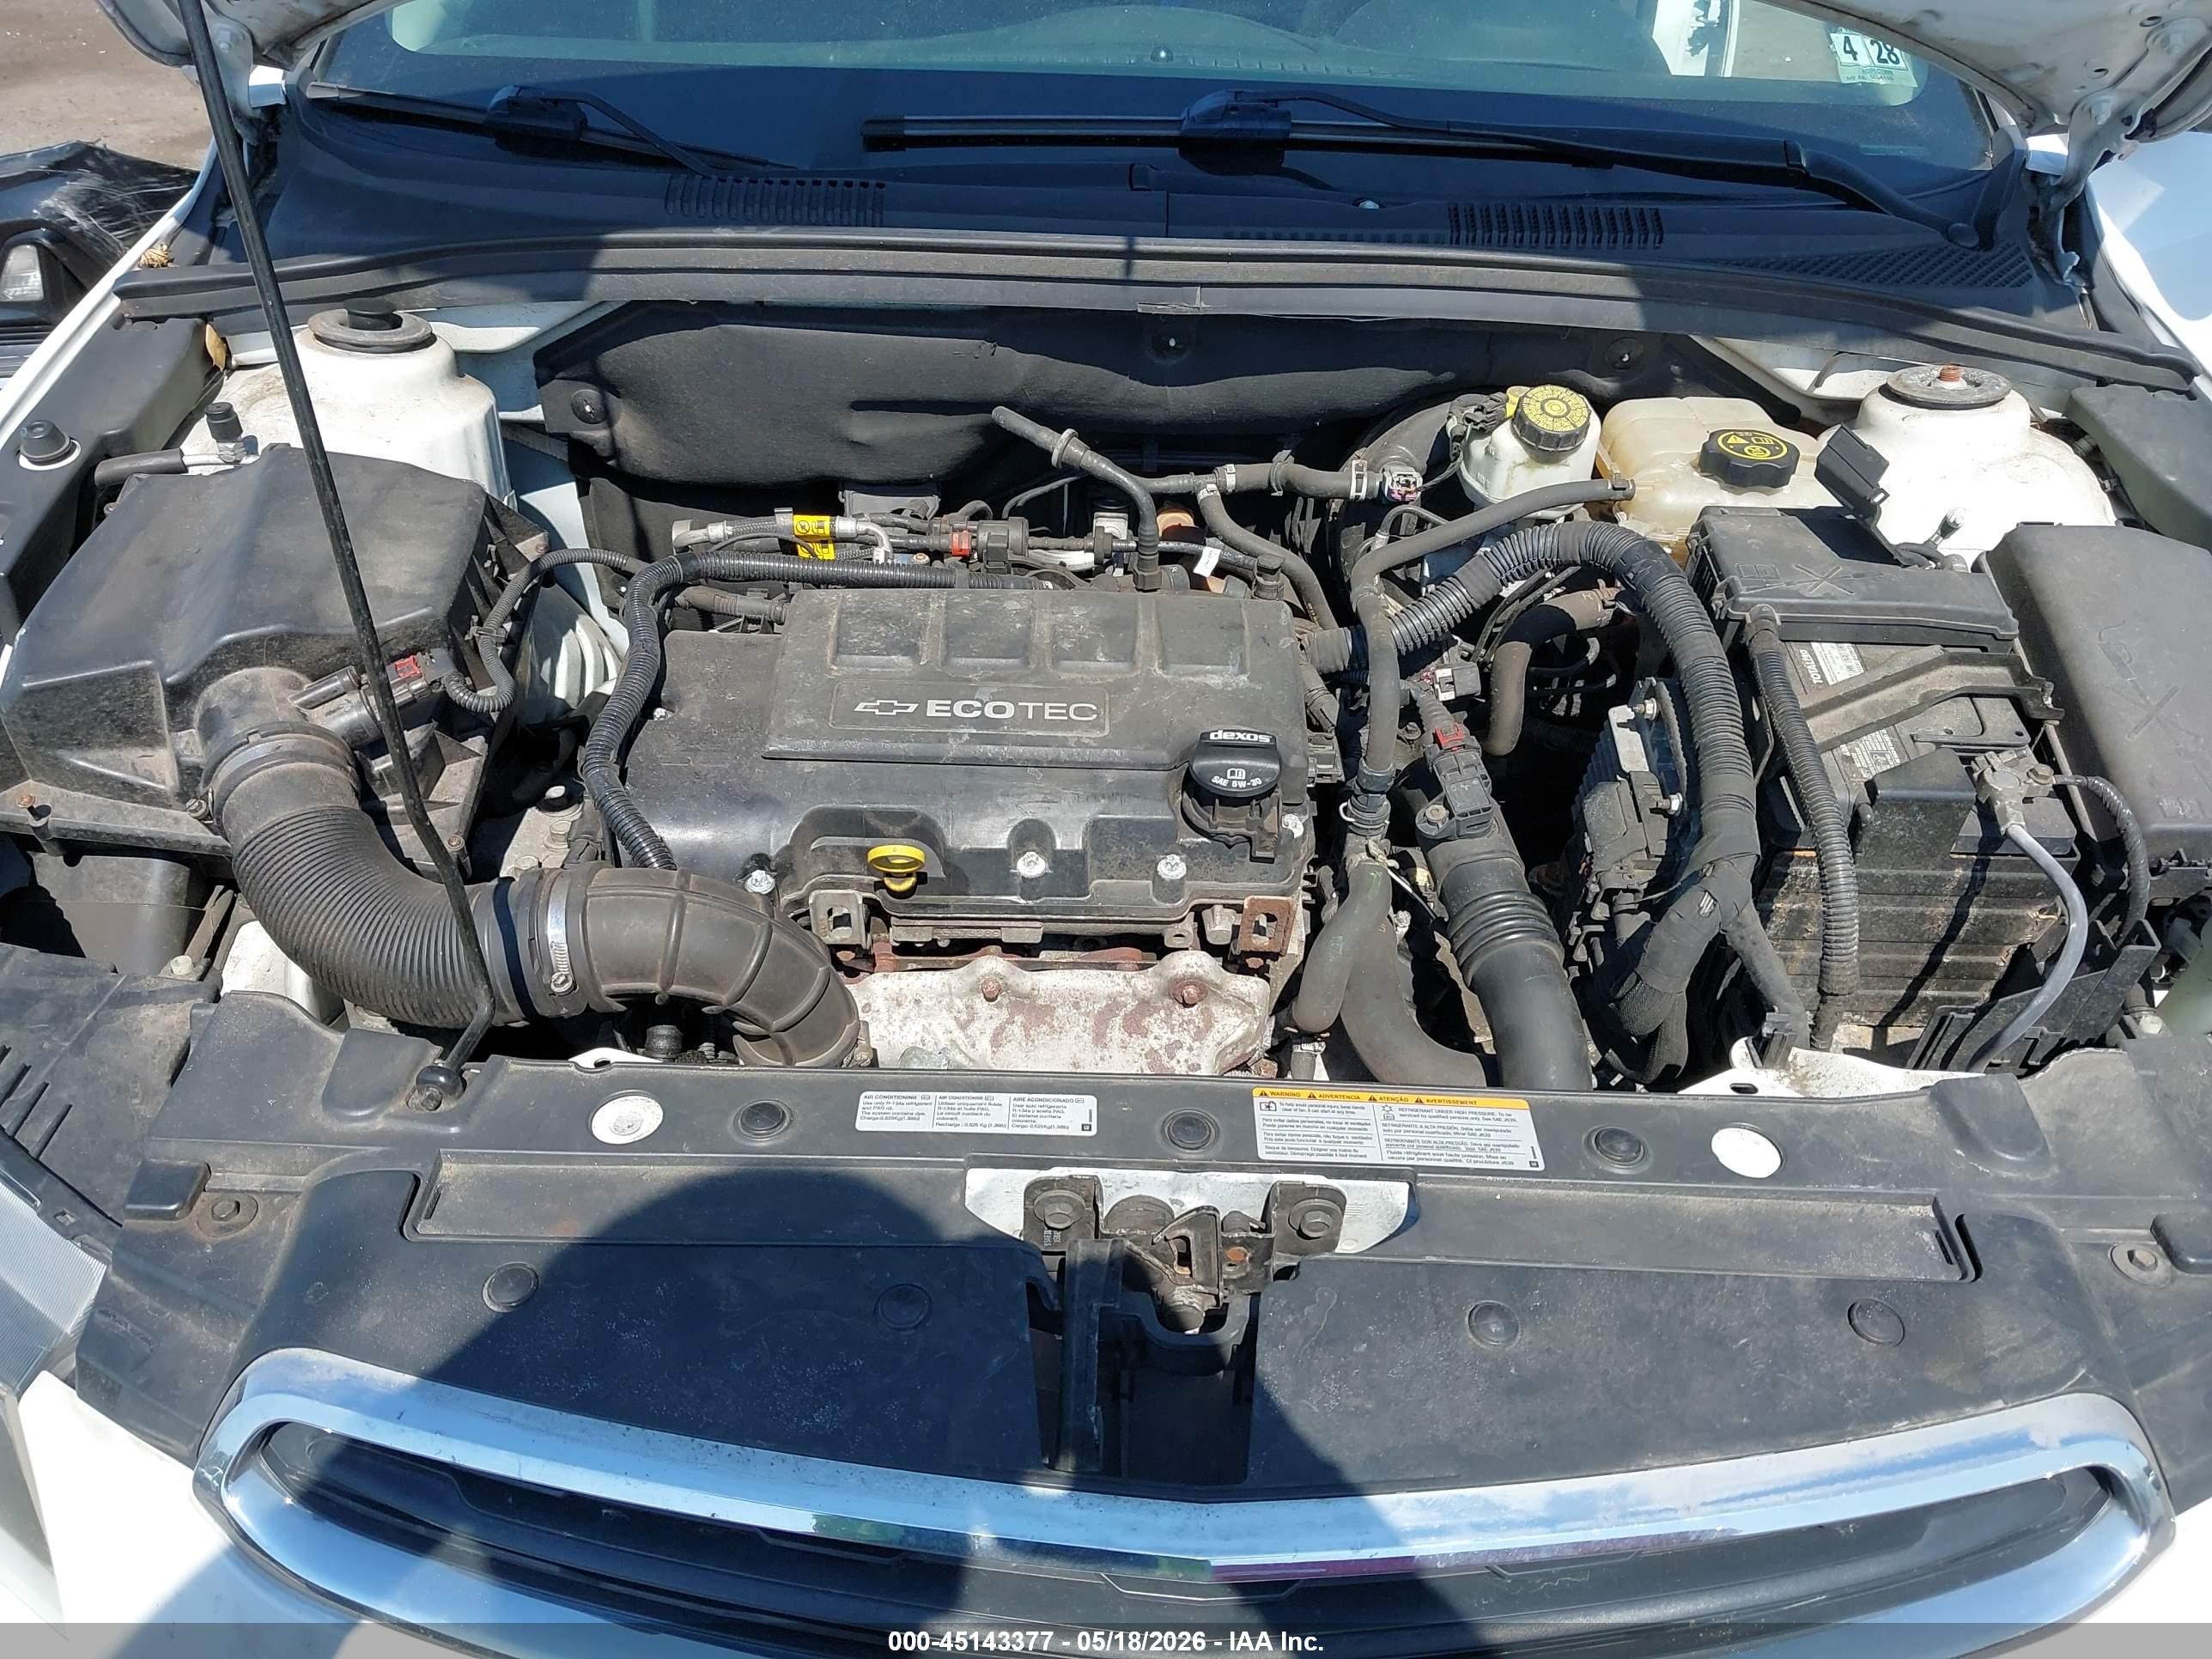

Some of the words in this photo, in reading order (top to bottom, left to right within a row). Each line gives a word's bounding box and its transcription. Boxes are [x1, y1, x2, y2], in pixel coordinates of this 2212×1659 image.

[1843, 36, 1857, 61] 4
[927, 700, 1098, 721] ECOTEC
[1209, 729, 1272, 742] dexos
[1211, 776, 1229, 787] SAE
[1426, 1098, 1477, 1106] AVERTISSEMENT
